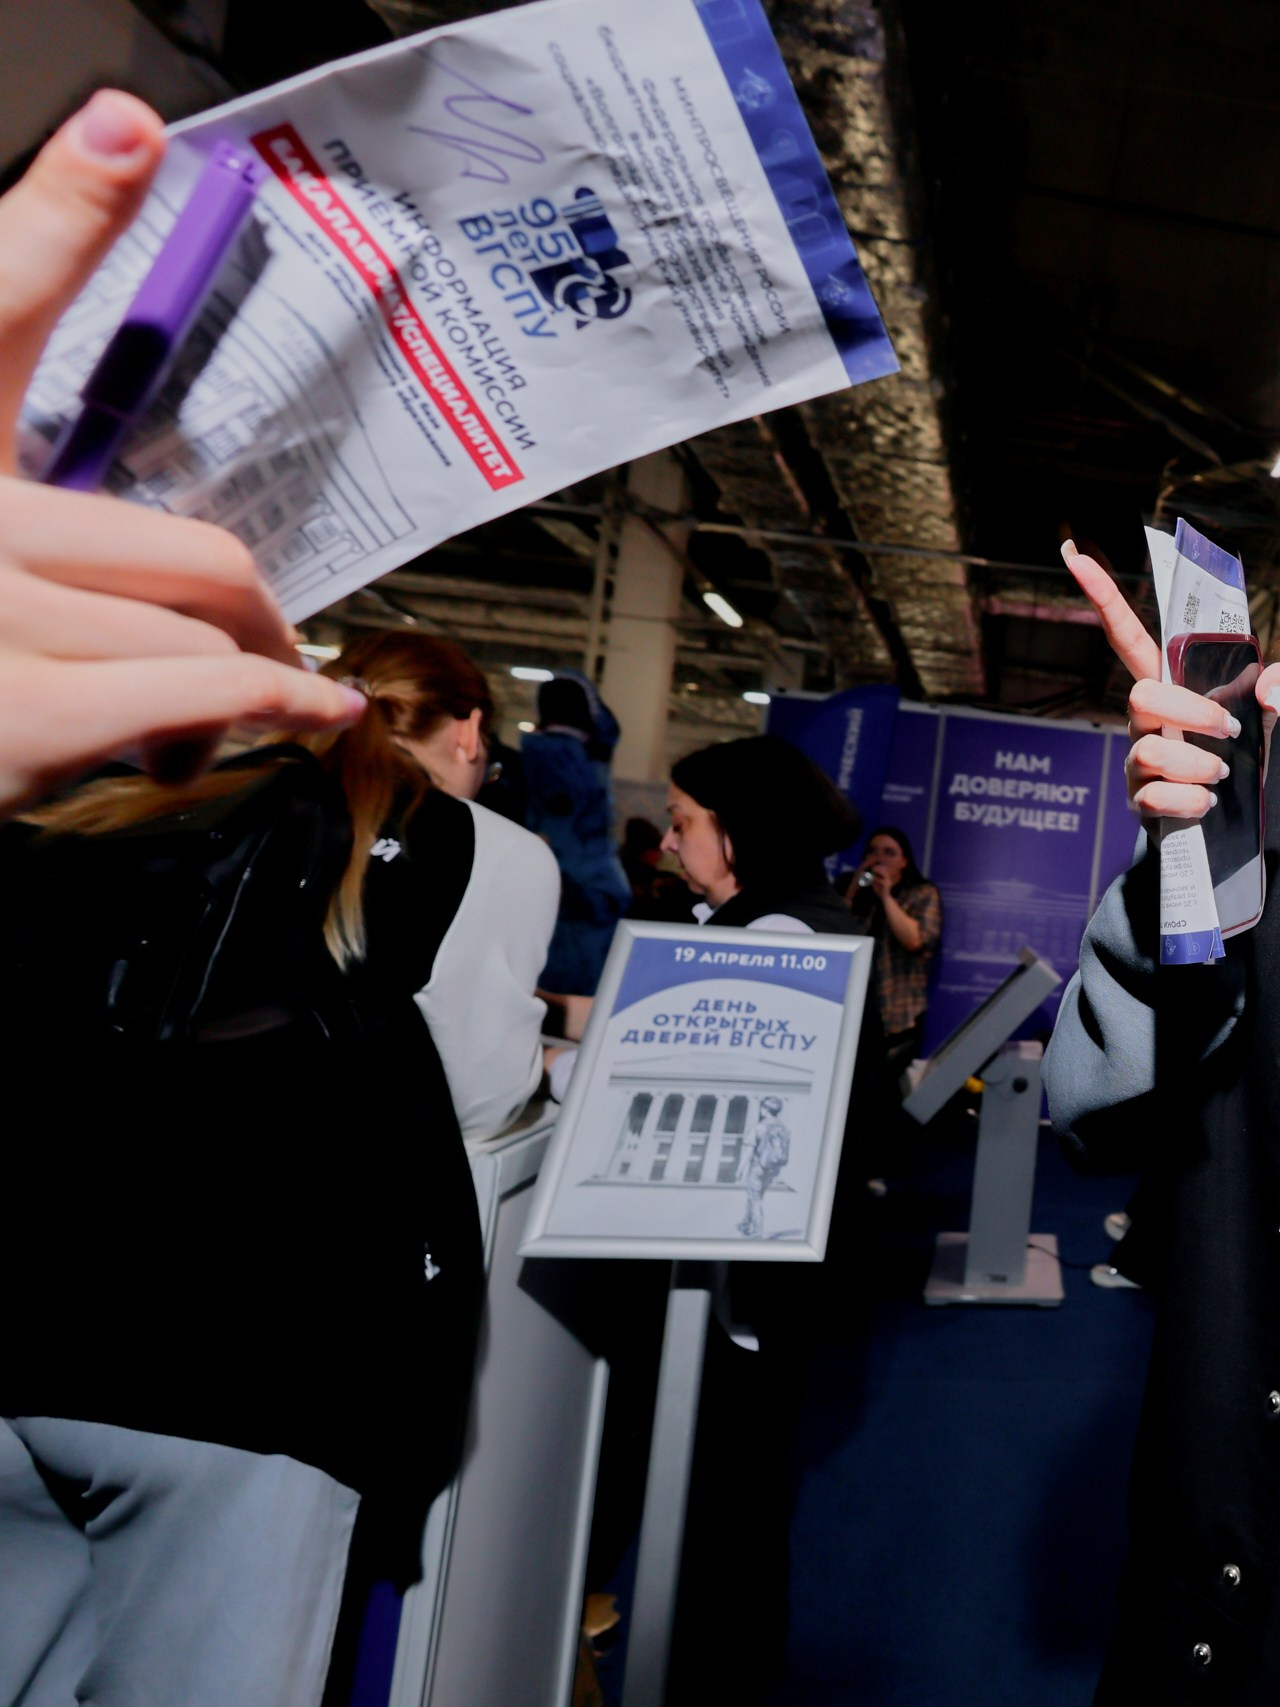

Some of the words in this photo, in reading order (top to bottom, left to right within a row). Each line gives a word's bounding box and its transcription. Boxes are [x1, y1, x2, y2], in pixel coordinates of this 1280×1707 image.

[639, 76, 707, 206] Федеральное
[515, 195, 583, 263] 95
[670, 75, 762, 266] МИНПРОСВЕЩЕНИЯ
[754, 265, 794, 335] РОССИИ
[491, 209, 541, 262] лет
[390, 190, 528, 391] ИНФОРМАЦИЯ
[456, 212, 559, 338] ВГСПУ
[267, 136, 514, 479] БАКАЛАВРИАТ/СПЕЦИАЛИТЕТ
[434, 308, 537, 451] КОМИССИИ
[949, 773, 1090, 805] ДОВЕРЯЮТ
[995, 751, 1051, 775] НАМ
[953, 802, 1080, 832] БУДУЩЕЕ!
[674, 946, 696, 962] 19
[699, 951, 774, 967] АПРЕЛЯ
[780, 954, 827, 971] 11.00
[652, 1013, 790, 1033] ОТКРЫТЫХ
[692, 998, 757, 1014] ДЕНЬ
[621, 1028, 719, 1046] ДВЕРЕЙ
[729, 1031, 817, 1051] ВГСПУ
